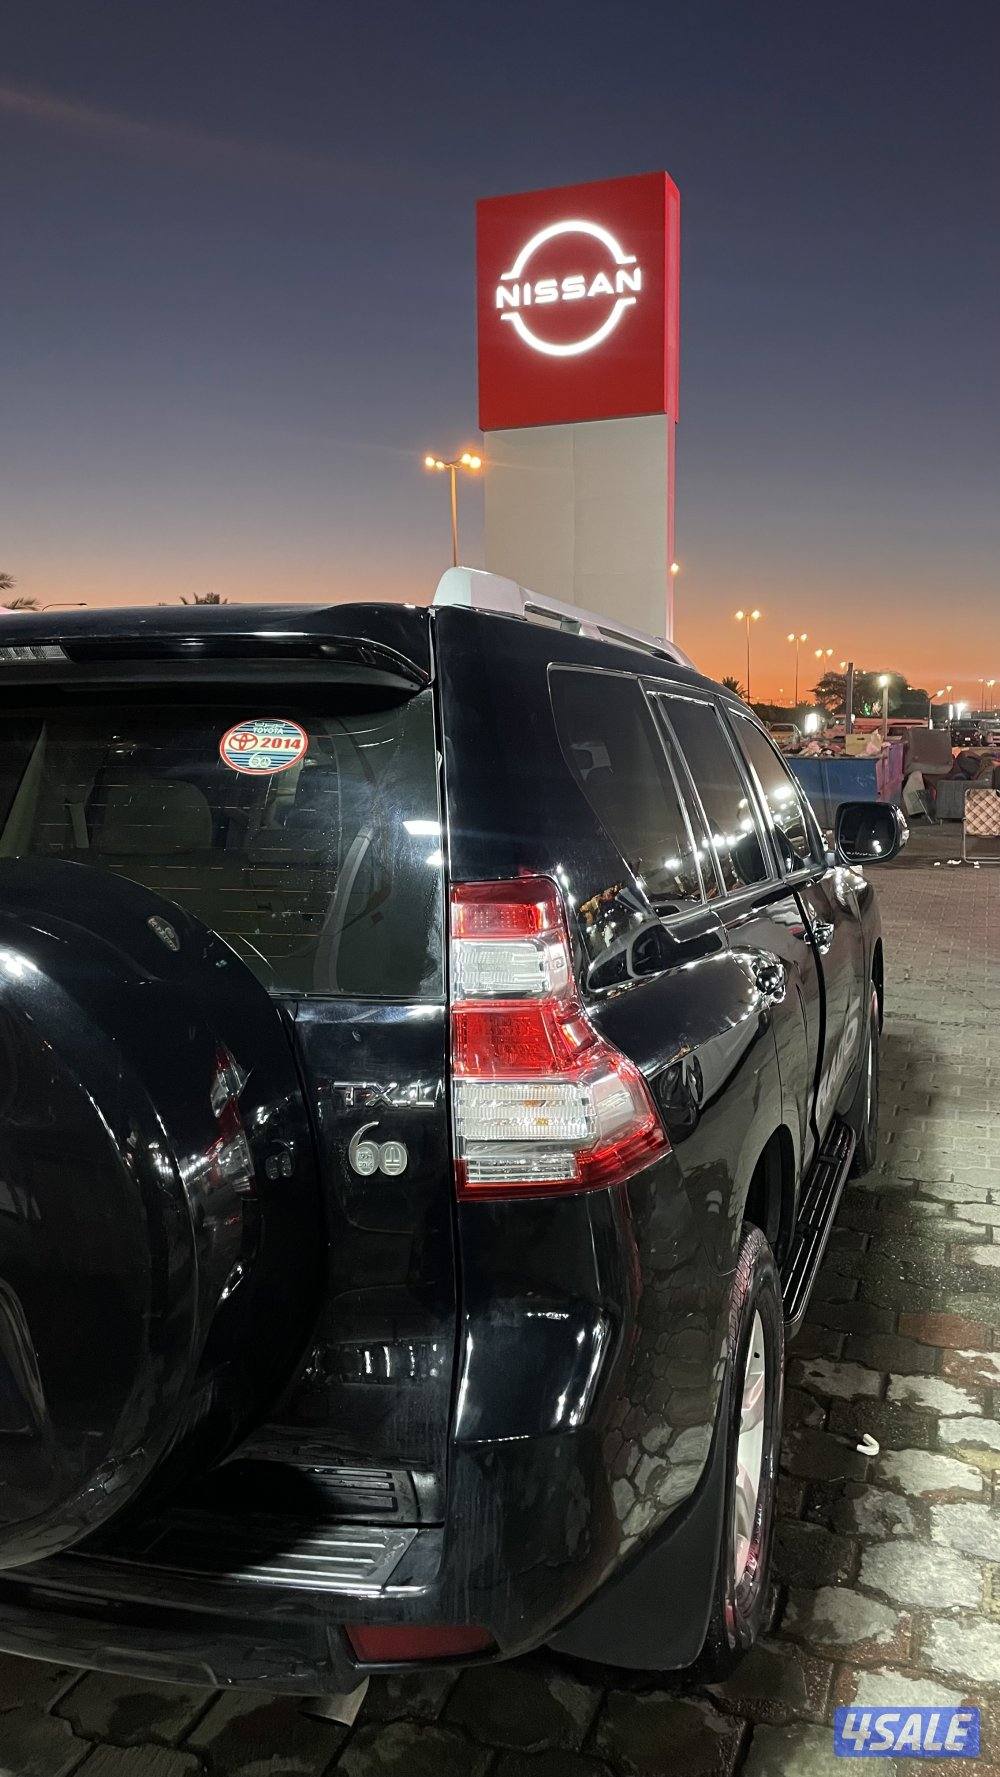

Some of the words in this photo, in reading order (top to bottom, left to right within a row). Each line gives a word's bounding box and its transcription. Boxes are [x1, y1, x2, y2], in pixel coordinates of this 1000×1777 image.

[496, 267, 641, 309] NISSAN
[253, 727, 284, 735] TOYOTA
[260, 738, 301, 749] 2014
